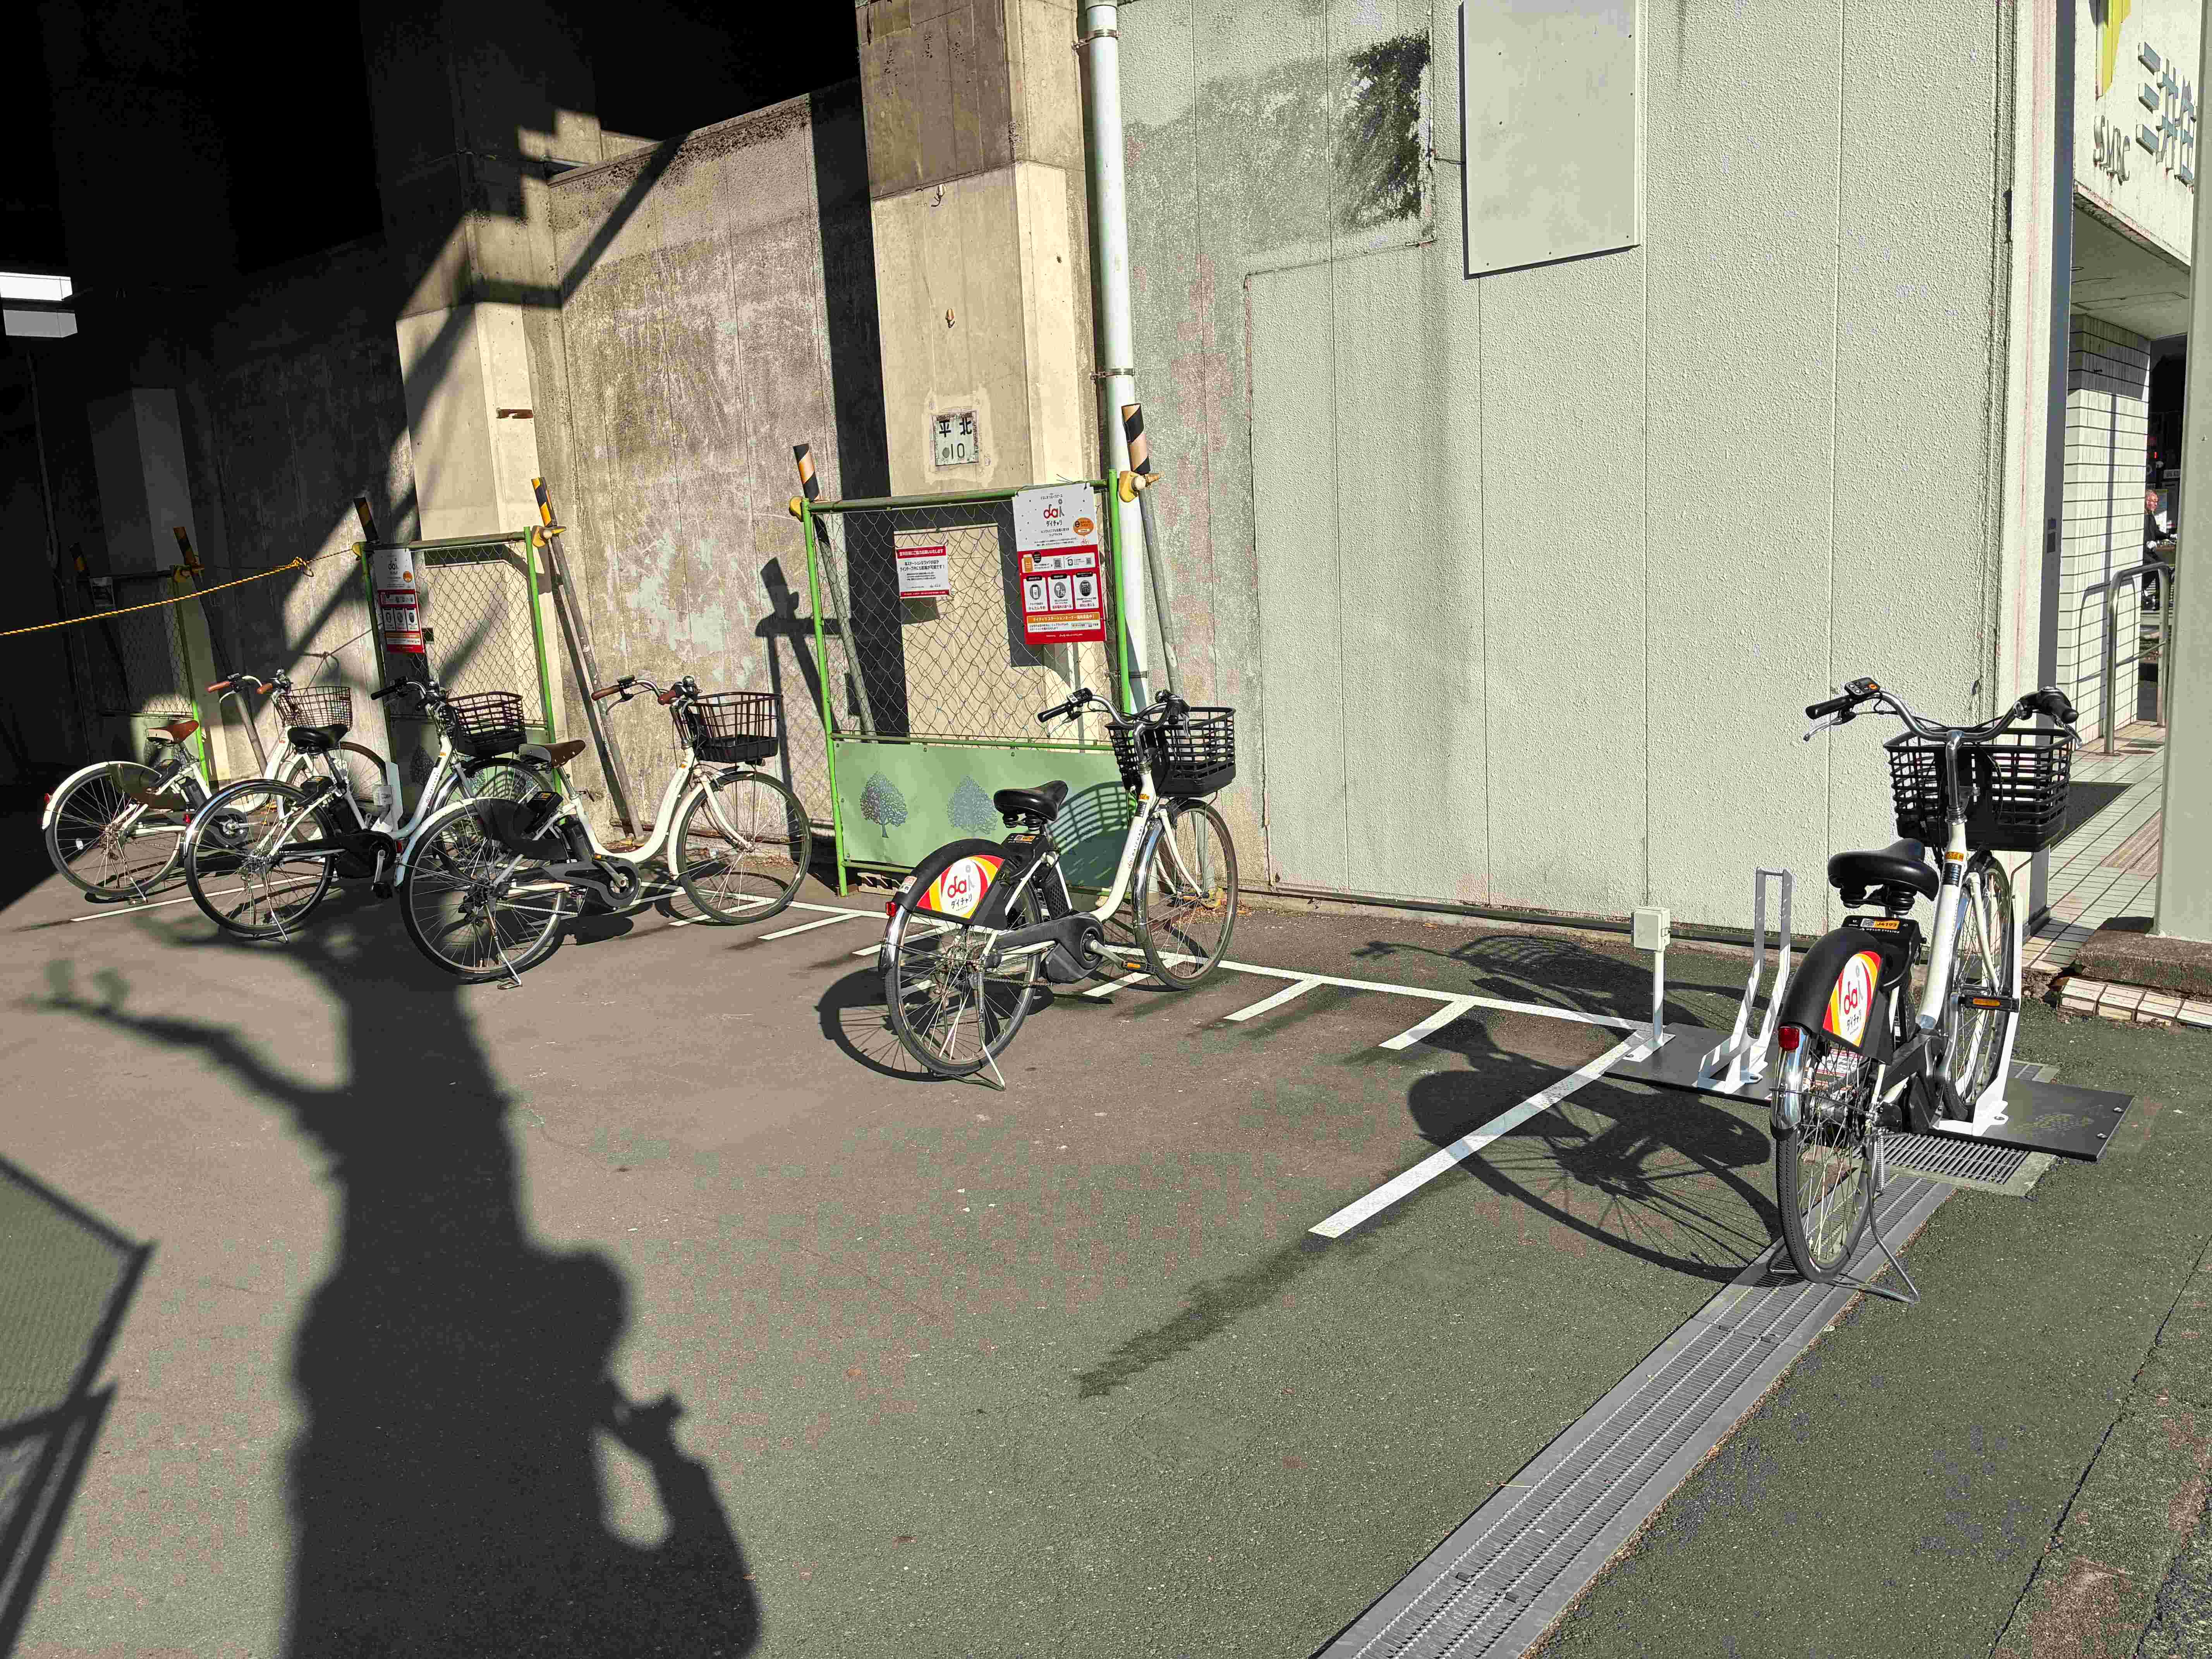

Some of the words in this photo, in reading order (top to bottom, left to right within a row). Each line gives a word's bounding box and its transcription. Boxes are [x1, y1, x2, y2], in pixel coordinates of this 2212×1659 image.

[947, 864, 976, 898] dai
[951, 894, 972, 909] ダイチャリ
[1844, 965, 1863, 1015] dai
[1846, 1009, 1862, 1032] ダイチャリ
